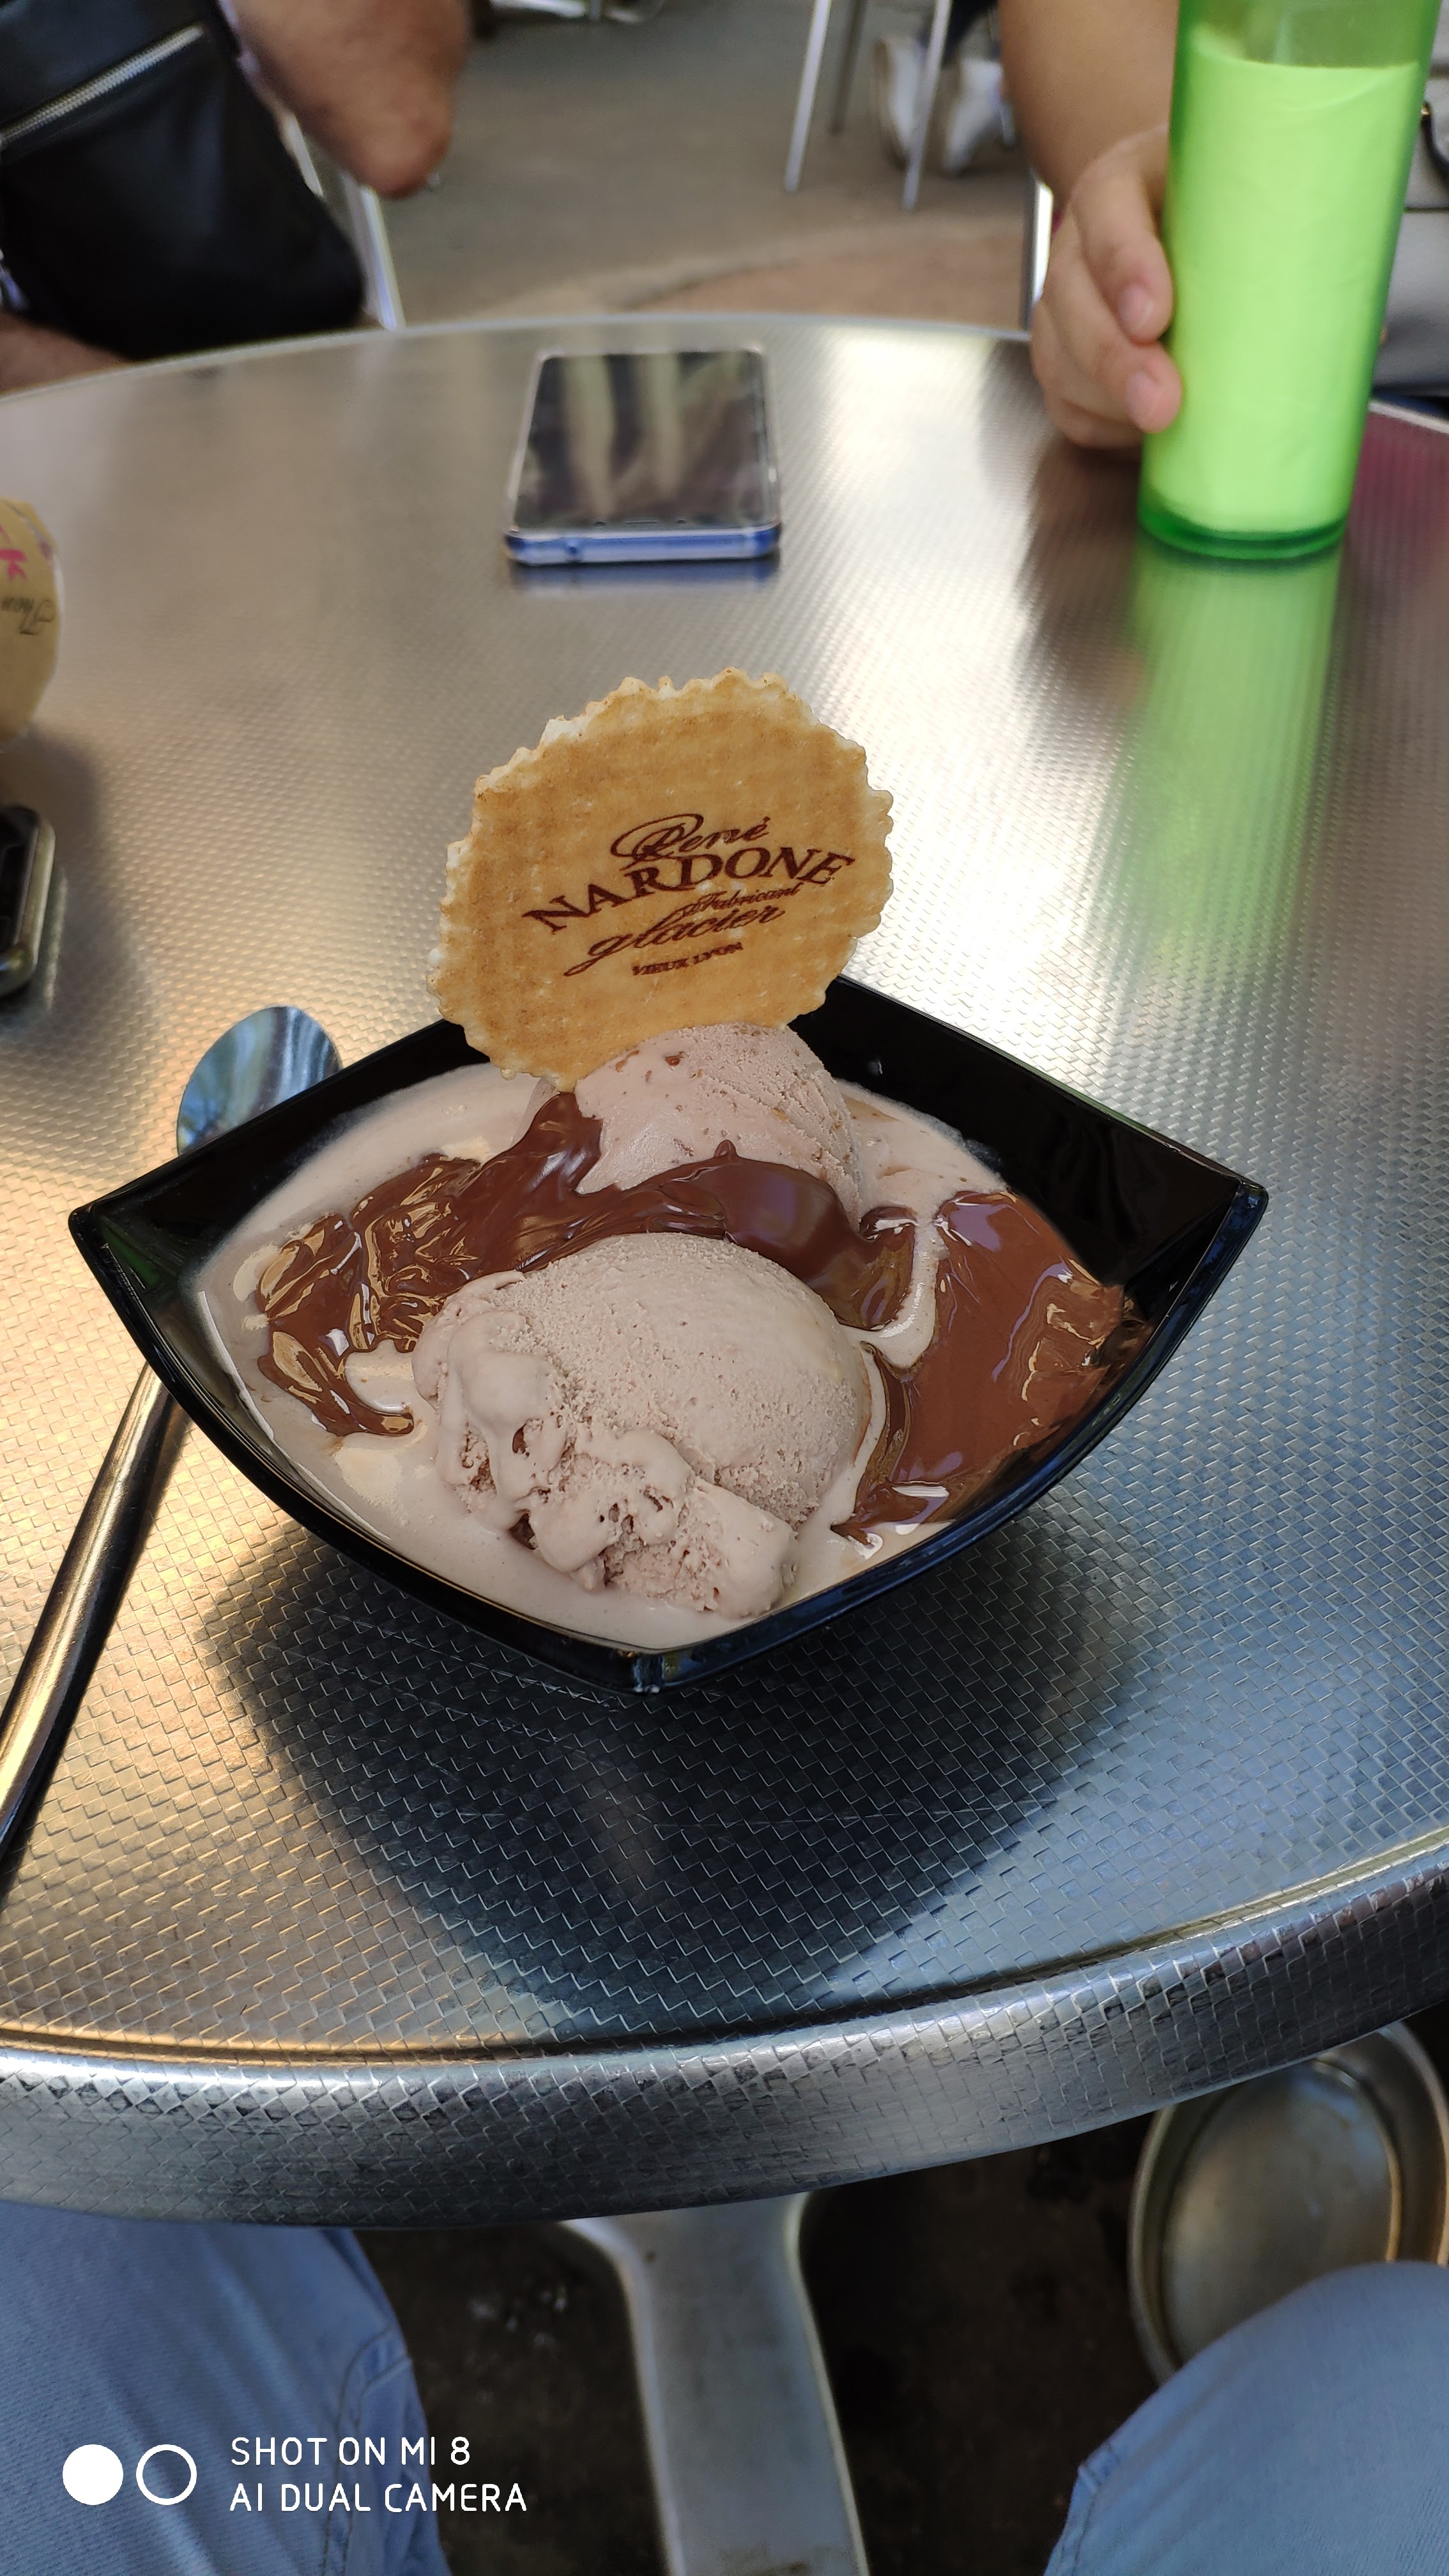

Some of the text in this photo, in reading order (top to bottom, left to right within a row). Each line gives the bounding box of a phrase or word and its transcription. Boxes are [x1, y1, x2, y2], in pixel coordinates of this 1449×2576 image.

[611, 813, 770, 871] René
[523, 847, 855, 934] NARDONE
[564, 905, 786, 976] glacier
